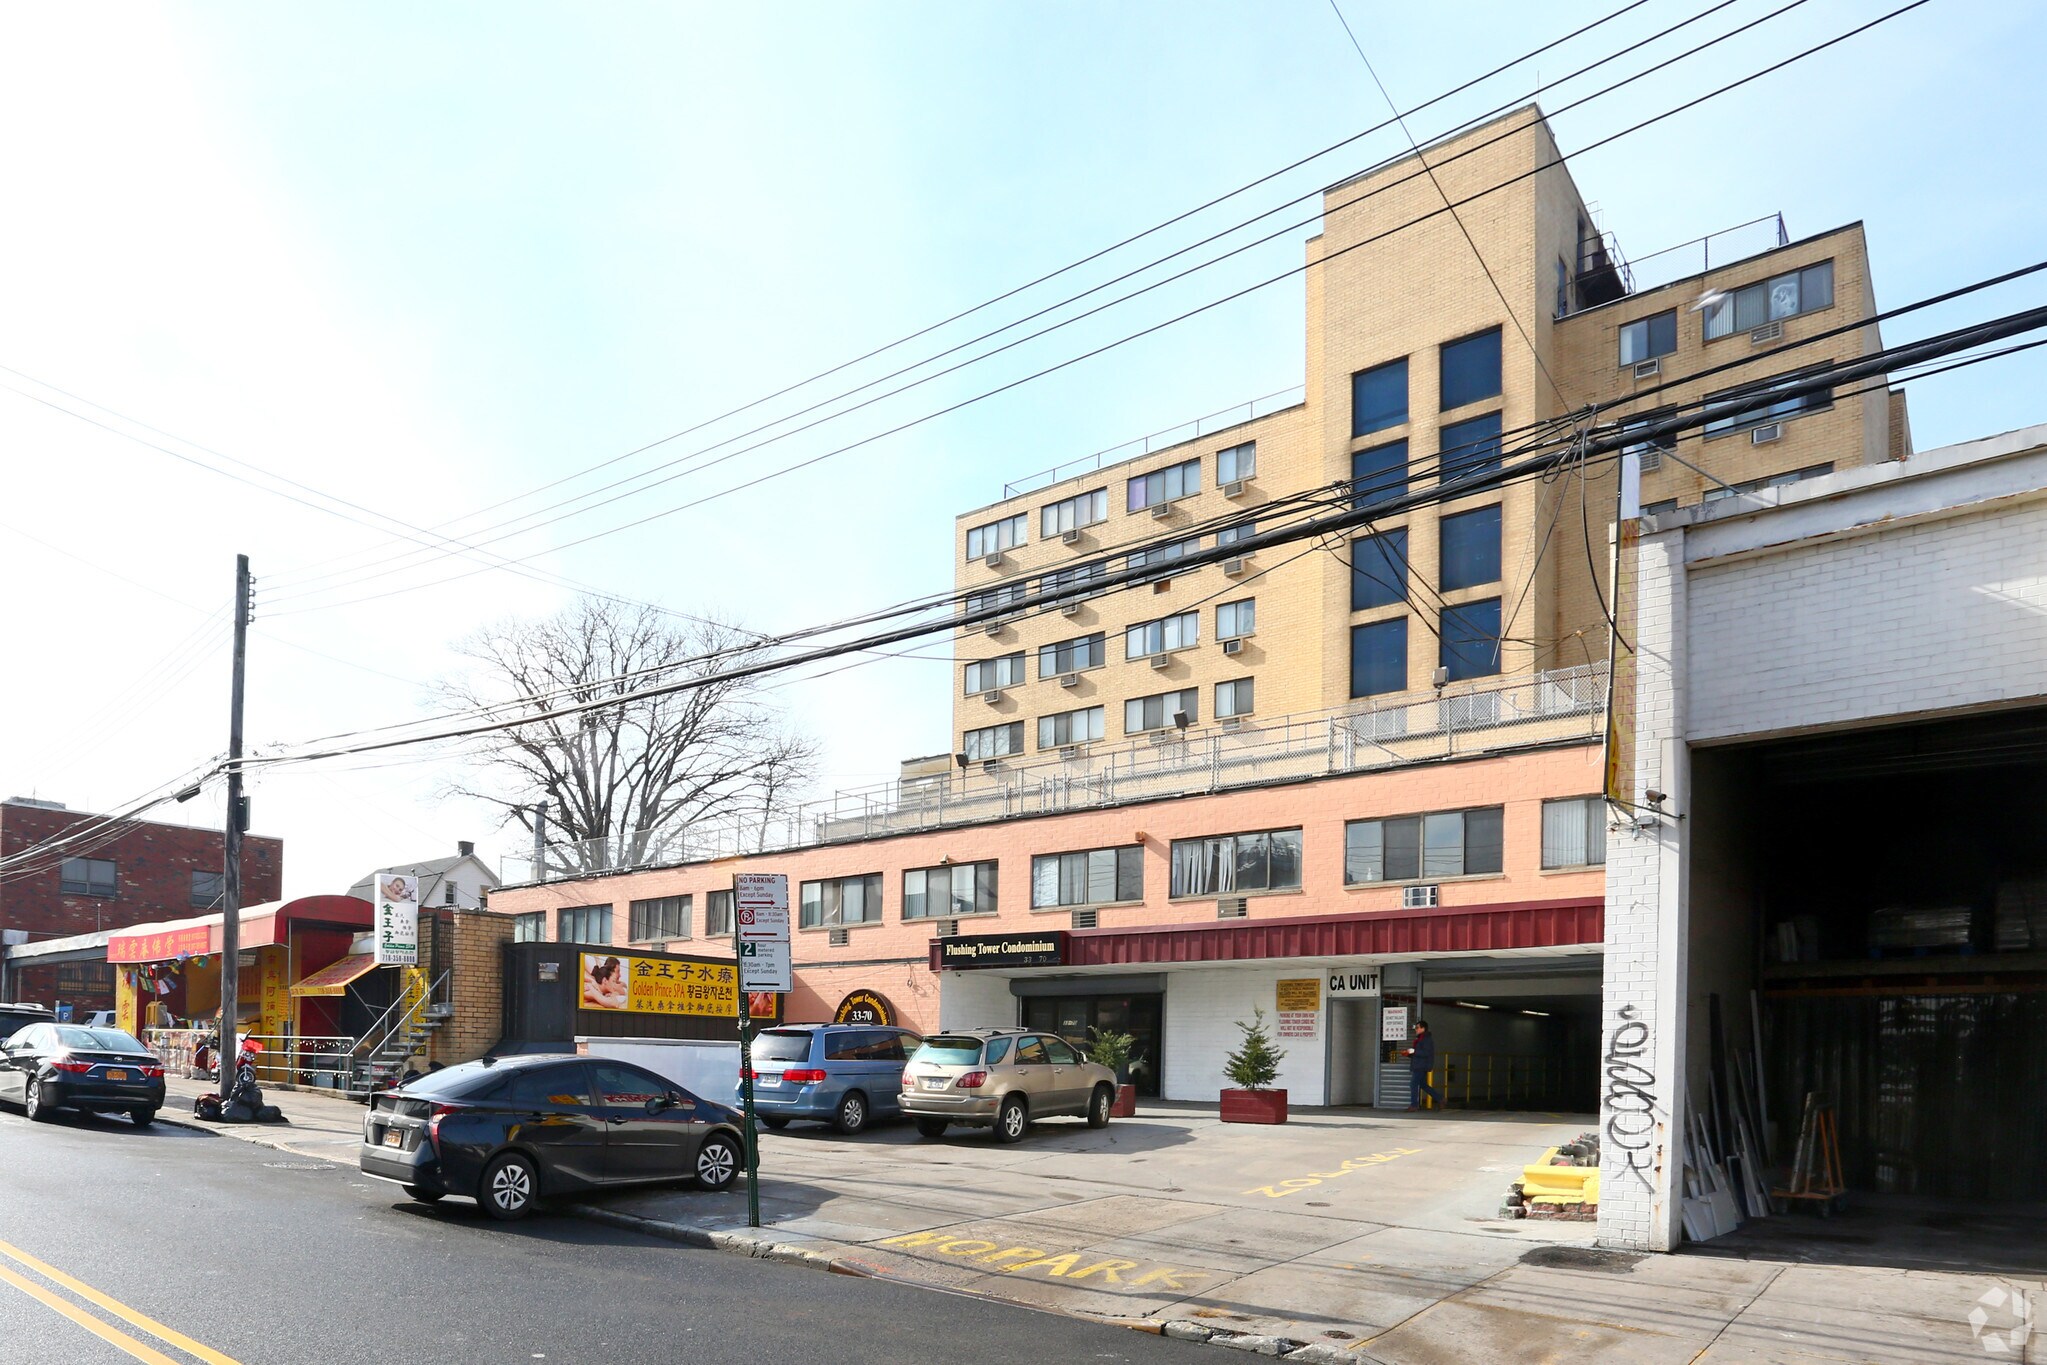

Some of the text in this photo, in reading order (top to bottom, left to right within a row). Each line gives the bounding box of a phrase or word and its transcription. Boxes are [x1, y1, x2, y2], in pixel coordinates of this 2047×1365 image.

[744, 943, 752, 955] 2
[946, 940, 1054, 958] Flushing Tower Condominium
[635, 960, 733, 983] 金王子水療
[632, 980, 654, 996] Golden
[655, 982, 672, 998] Prince
[674, 983, 685, 998] SPA
[1330, 974, 1378, 991] CA UNIT
[850, 995, 864, 1005] Tower
[852, 1010, 872, 1020] 33-70
